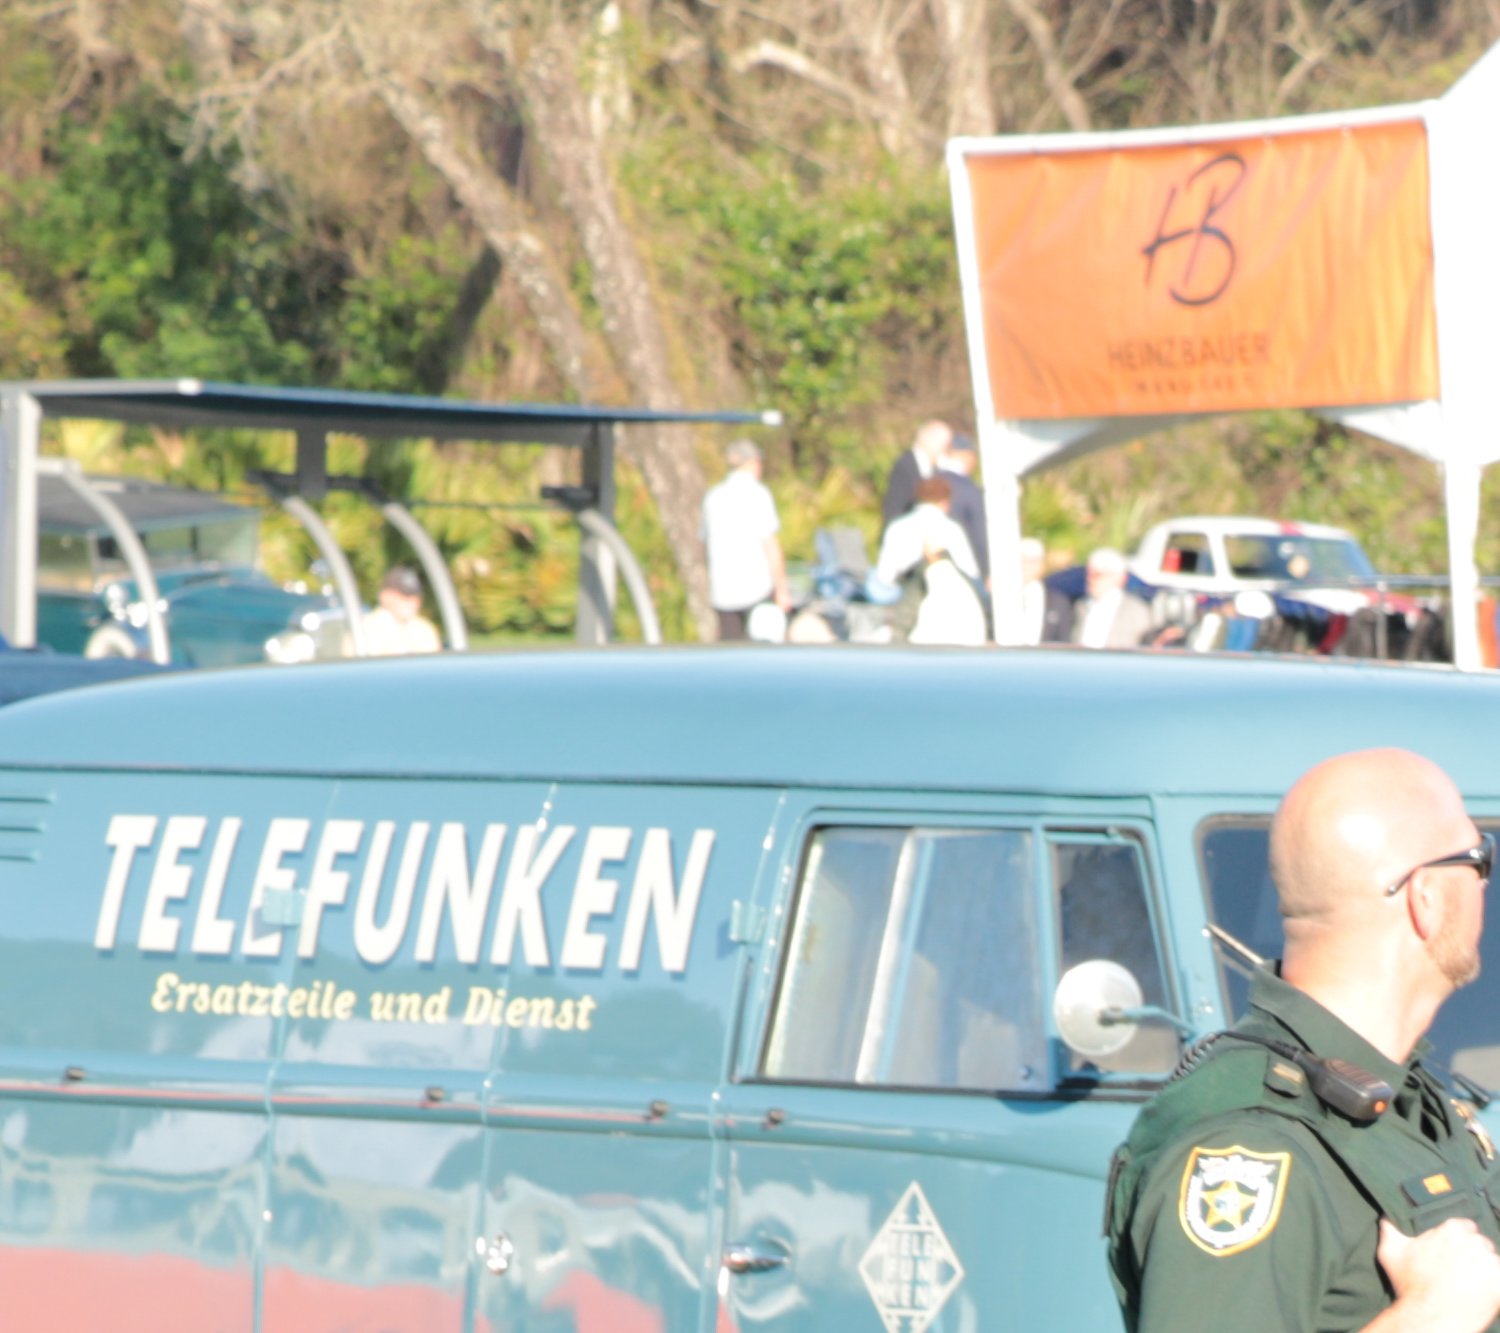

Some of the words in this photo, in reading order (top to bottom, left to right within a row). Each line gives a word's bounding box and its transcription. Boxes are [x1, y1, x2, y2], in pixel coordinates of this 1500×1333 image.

[1107, 331, 1270, 371] HEINZBAUER
[94, 815, 715, 972] TELEFUNKEN
[150, 972, 357, 1022] Ersatzteile
[369, 985, 449, 1026] und
[462, 987, 597, 1031] Dienst
